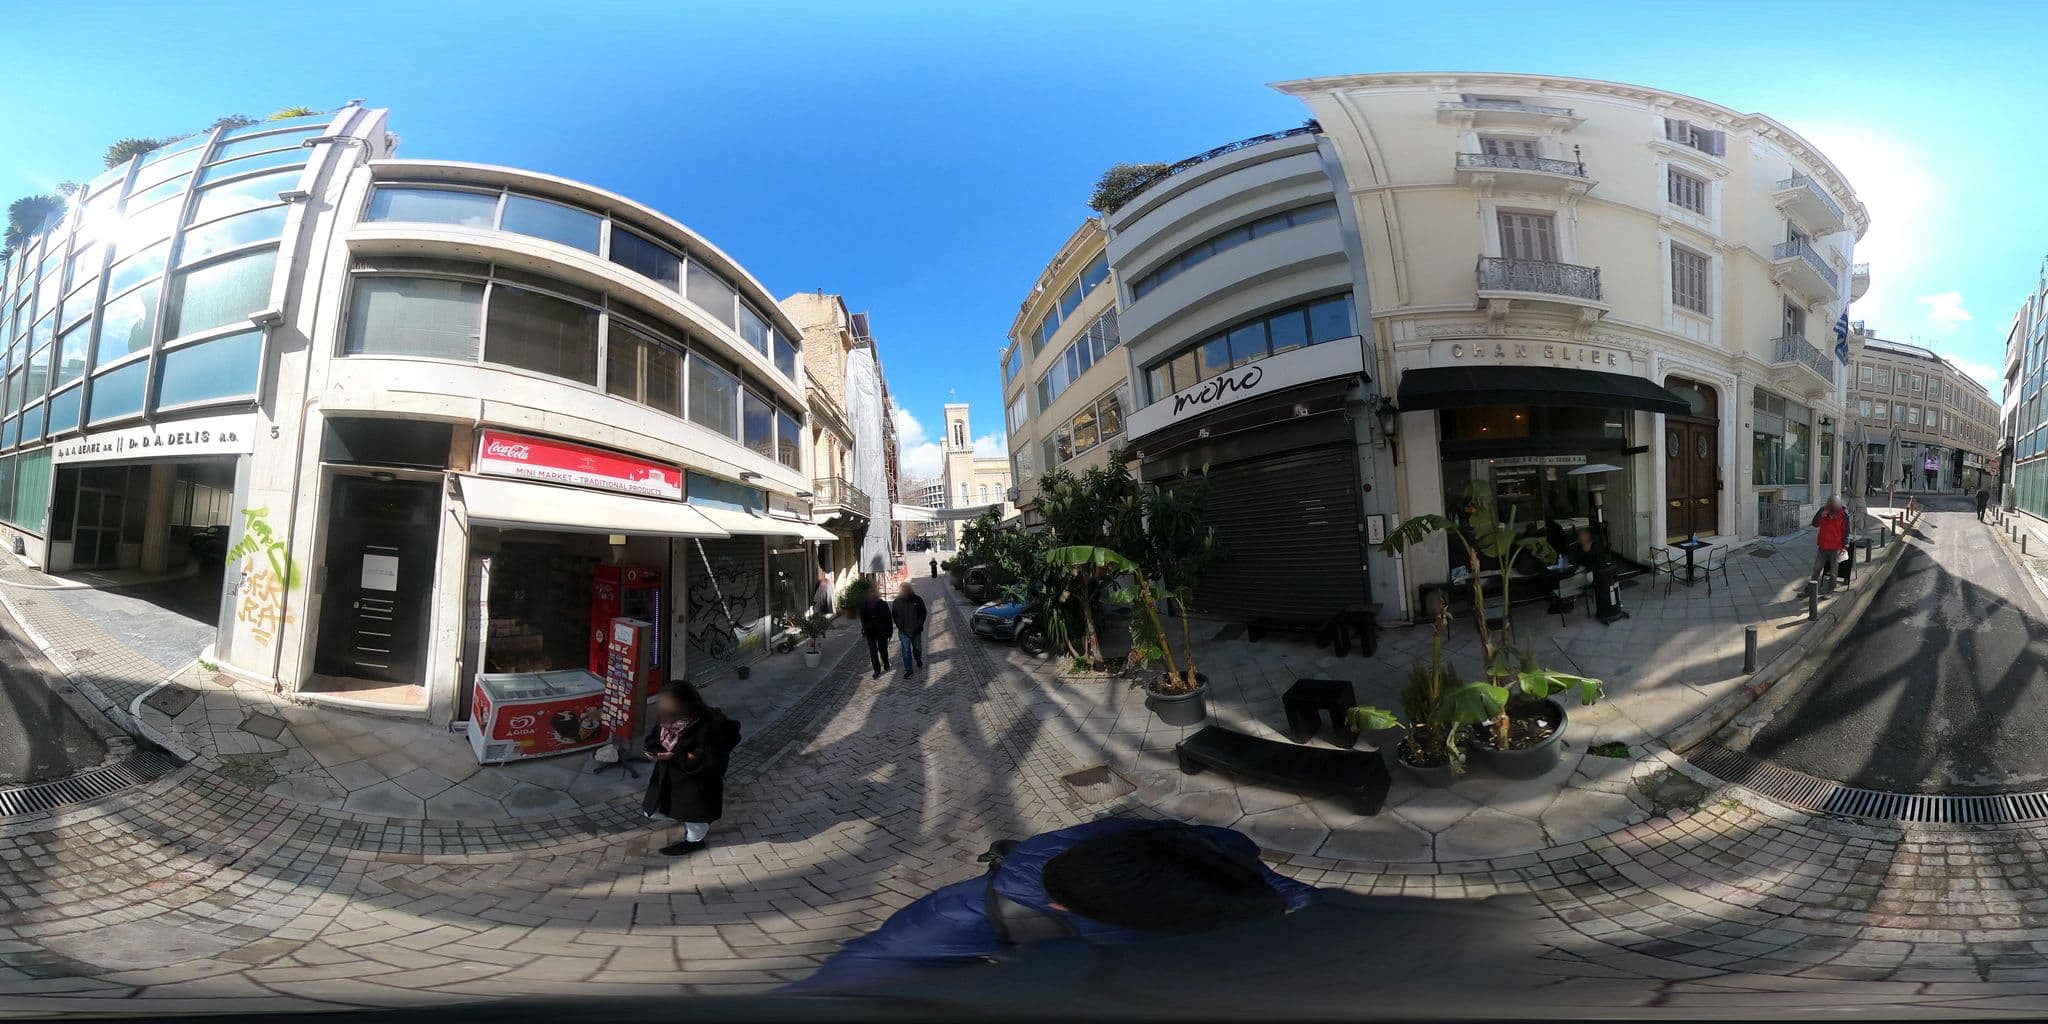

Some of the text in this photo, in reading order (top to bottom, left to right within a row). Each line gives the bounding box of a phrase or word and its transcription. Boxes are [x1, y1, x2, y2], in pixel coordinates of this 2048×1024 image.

[168, 430, 210, 445] DELIS
[270, 426, 280, 439] 5
[516, 468, 536, 476] MINI
[538, 470, 572, 481] MARKET
[580, 476, 628, 489] TRADITIONAL
[629, 484, 663, 496] PRODUCTS
